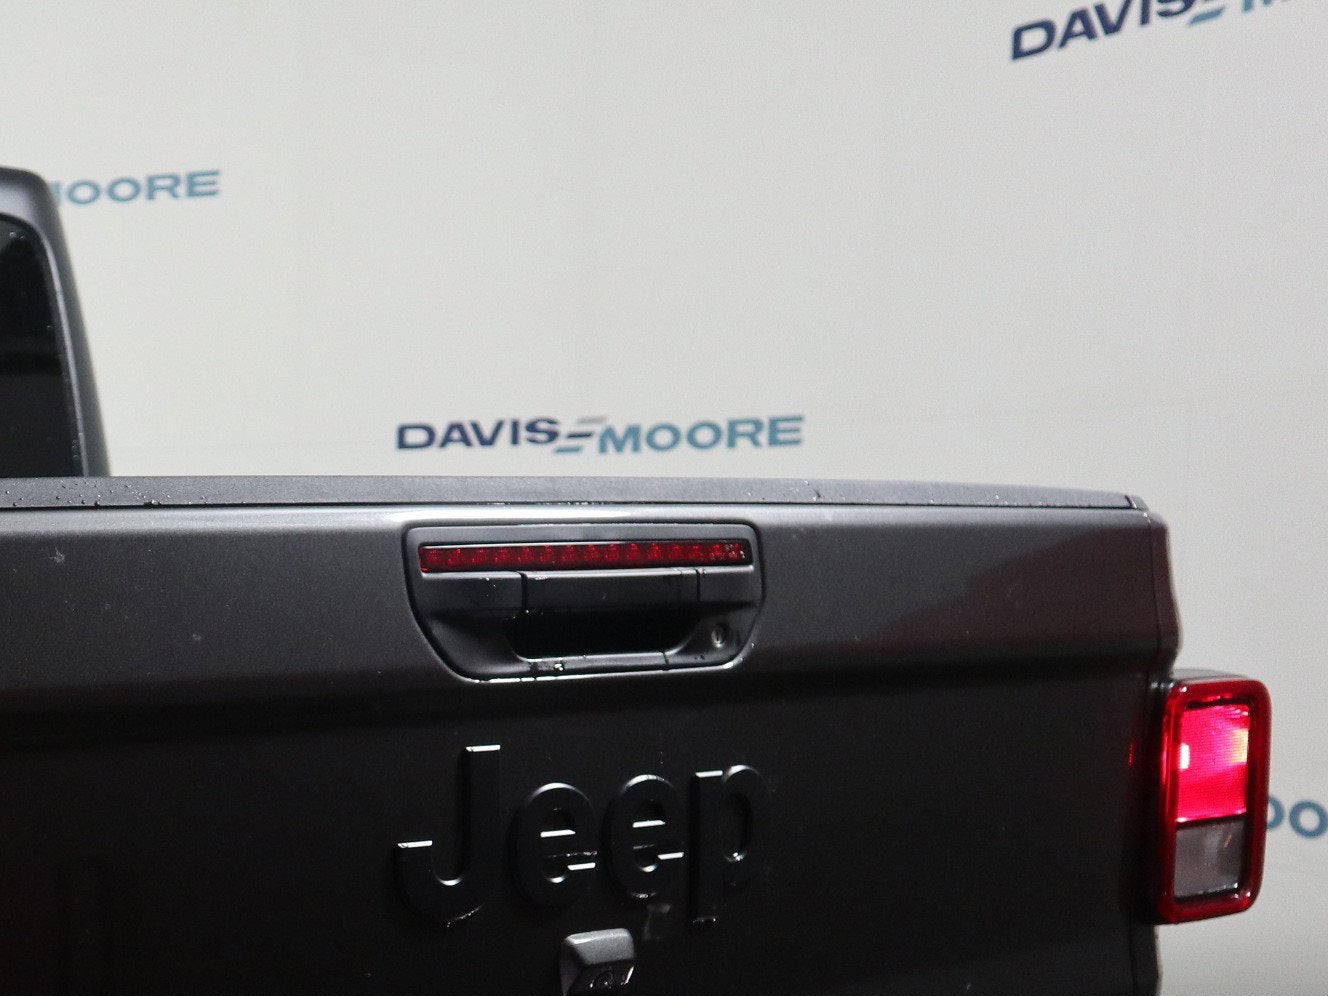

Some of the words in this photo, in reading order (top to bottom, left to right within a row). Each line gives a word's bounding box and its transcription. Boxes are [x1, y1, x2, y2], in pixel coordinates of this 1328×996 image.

[48, 169, 220, 206] OORE
[395, 416, 560, 450] DAVIS
[596, 415, 804, 455] MOORE
[395, 743, 769, 927] Jeep
